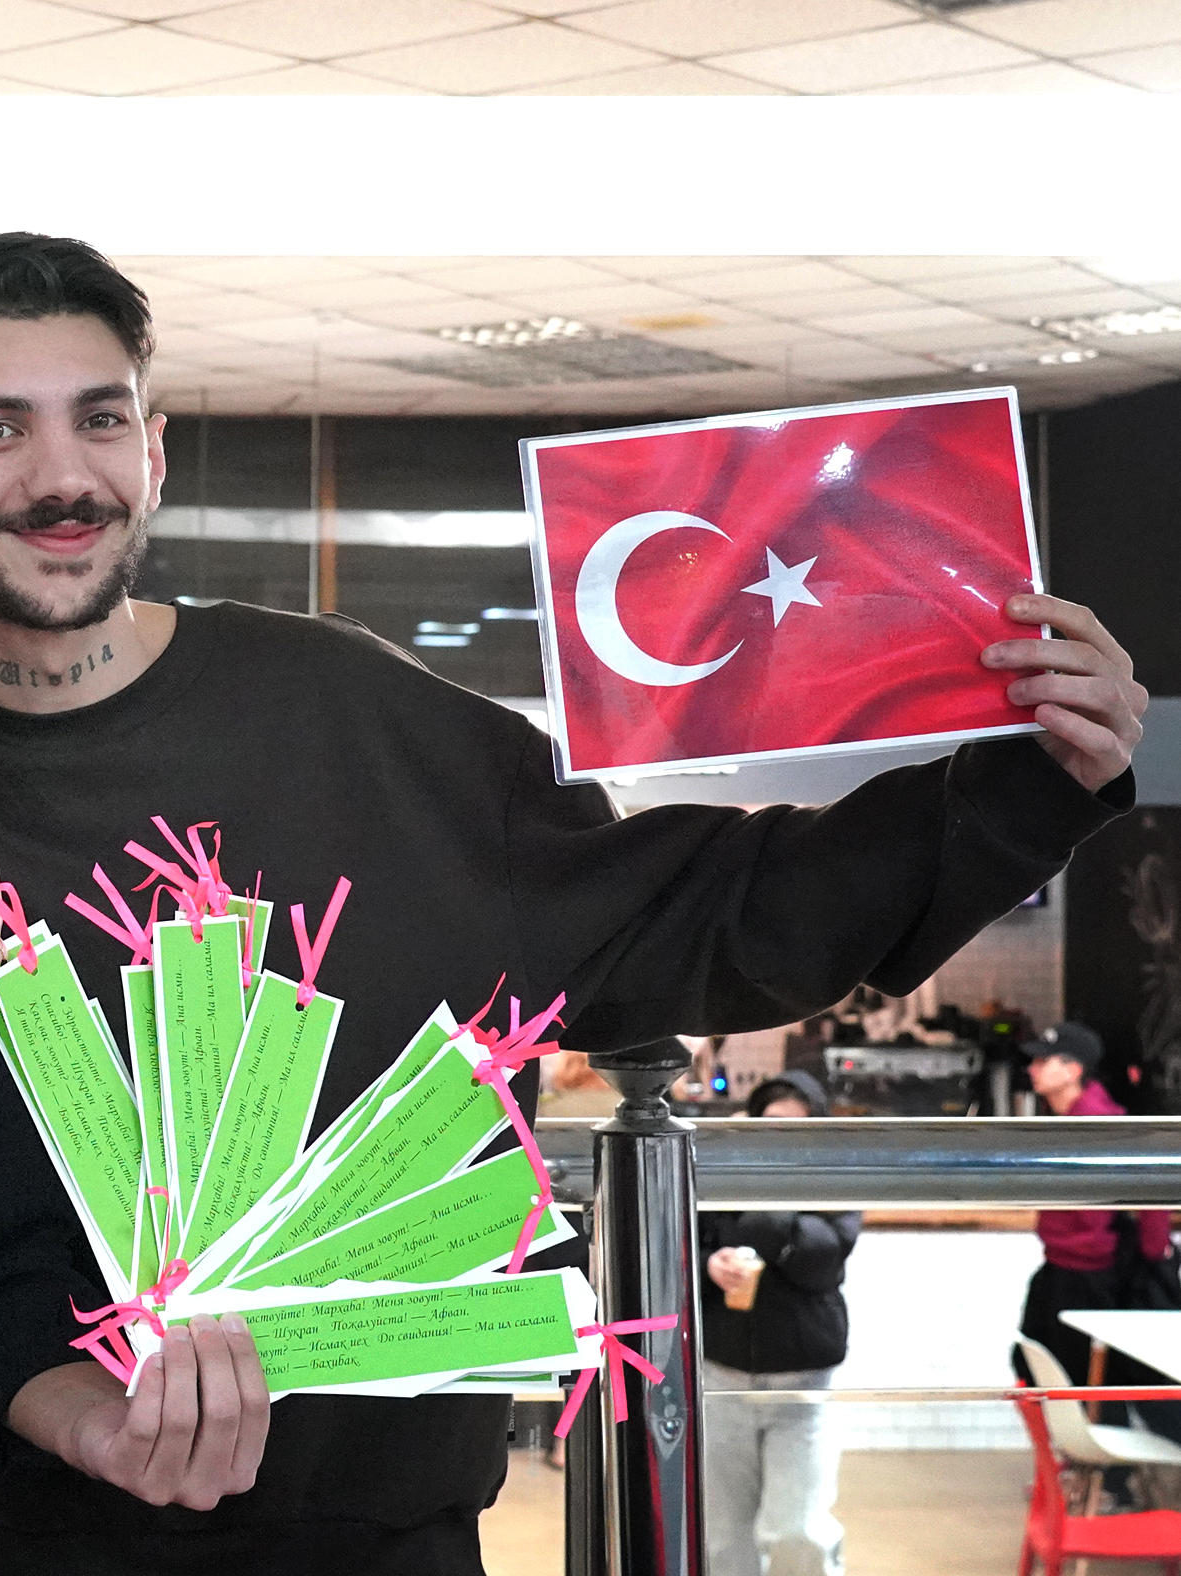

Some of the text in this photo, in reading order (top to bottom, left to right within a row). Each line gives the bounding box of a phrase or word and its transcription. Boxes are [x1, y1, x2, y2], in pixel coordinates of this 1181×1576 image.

[205, 937, 215, 983] салама.
[13, 1005, 28, 1017] Я
[142, 1001, 157, 1018] Я
[206, 984, 216, 998] ил
[206, 1001, 218, 1022] Ма
[19, 1018, 37, 1047] тебя
[146, 1017, 158, 1047] тебя
[175, 1004, 188, 1030] Ана
[291, 1007, 310, 1050] салама.
[191, 1025, 208, 1068] Афван.
[286, 1050, 297, 1066] ил
[30, 1048, 57, 1089] люблю!
[61, 1006, 143, 1170] Здравствуйте! Мархаба! Ме
[177, 1049, 194, 1089] зовут!
[208, 1042, 225, 1100] свидания!
[278, 1065, 292, 1087] Ма
[39, 992, 69, 1042] Спасибо!
[69, 1059, 96, 1106] Шукран
[95, 1114, 140, 1189] Пожалуйста!
[183, 1090, 196, 1125] Меня
[28, 999, 43, 1029] Как
[37, 1025, 51, 1043] вас
[45, 1044, 70, 1081] зовут?
[71, 1099, 95, 1142] Исмак
[103, 1163, 116, 1183] До
[111, 1183, 137, 1229] свидани
[57, 1106, 85, 1156] Бахибак.
[197, 1087, 215, 1147] алуйста!
[258, 1104, 281, 1162] свидания!
[184, 1130, 203, 1188] Мархаба!
[203, 1173, 227, 1232] Мархаба!
[220, 1137, 238, 1172] Меня
[232, 1097, 249, 1138] зовут!
[247, 1055, 262, 1083] Ана
[223, 1140, 254, 1221] Пожалуйста!
[251, 1083, 271, 1126] Афван.
[354, 1204, 370, 1220] До
[369, 1159, 410, 1207] свидания!
[420, 1132, 439, 1152] Ма
[436, 1121, 450, 1135] ил
[448, 1089, 483, 1124] салама.
[251, 1161, 265, 1181] До
[287, 1195, 330, 1244] Мархаба!
[329, 1169, 356, 1198] Меня
[355, 1137, 384, 1172] зовут!
[394, 1108, 415, 1133] Ана
[311, 1178, 369, 1240] Пожалуйста!
[379, 1137, 412, 1173] Афван.
[290, 1255, 342, 1287] Мархаба!
[344, 1241, 375, 1263] Меня
[376, 1221, 411, 1247] зовут!
[428, 1205, 452, 1225] Ана
[445, 1237, 466, 1254] Ма
[466, 1231, 482, 1244] ил
[482, 1213, 524, 1237] салама.
[314, 1254, 383, 1289] луйста!
[400, 1232, 439, 1258] Афван.
[245, 1306, 306, 1325] вствуйте!
[311, 1298, 366, 1319] Мархаба!
[371, 1297, 405, 1310] Меня
[406, 1290, 444, 1308] зовут!
[463, 1286, 489, 1301] Ана
[271, 1325, 319, 1342] Шукран
[330, 1311, 408, 1333] Пожалуйста!
[427, 1305, 470, 1324] Афван.
[258, 1345, 289, 1362] вут?
[308, 1338, 351, 1354] Исмак
[376, 1332, 395, 1344] До
[396, 1324, 453, 1342] свидания!
[474, 1320, 495, 1334] Ма
[497, 1320, 512, 1330] ил
[513, 1314, 559, 1328] салама.
[262, 1362, 290, 1376] блю!
[309, 1352, 362, 1371] Бахибак.
